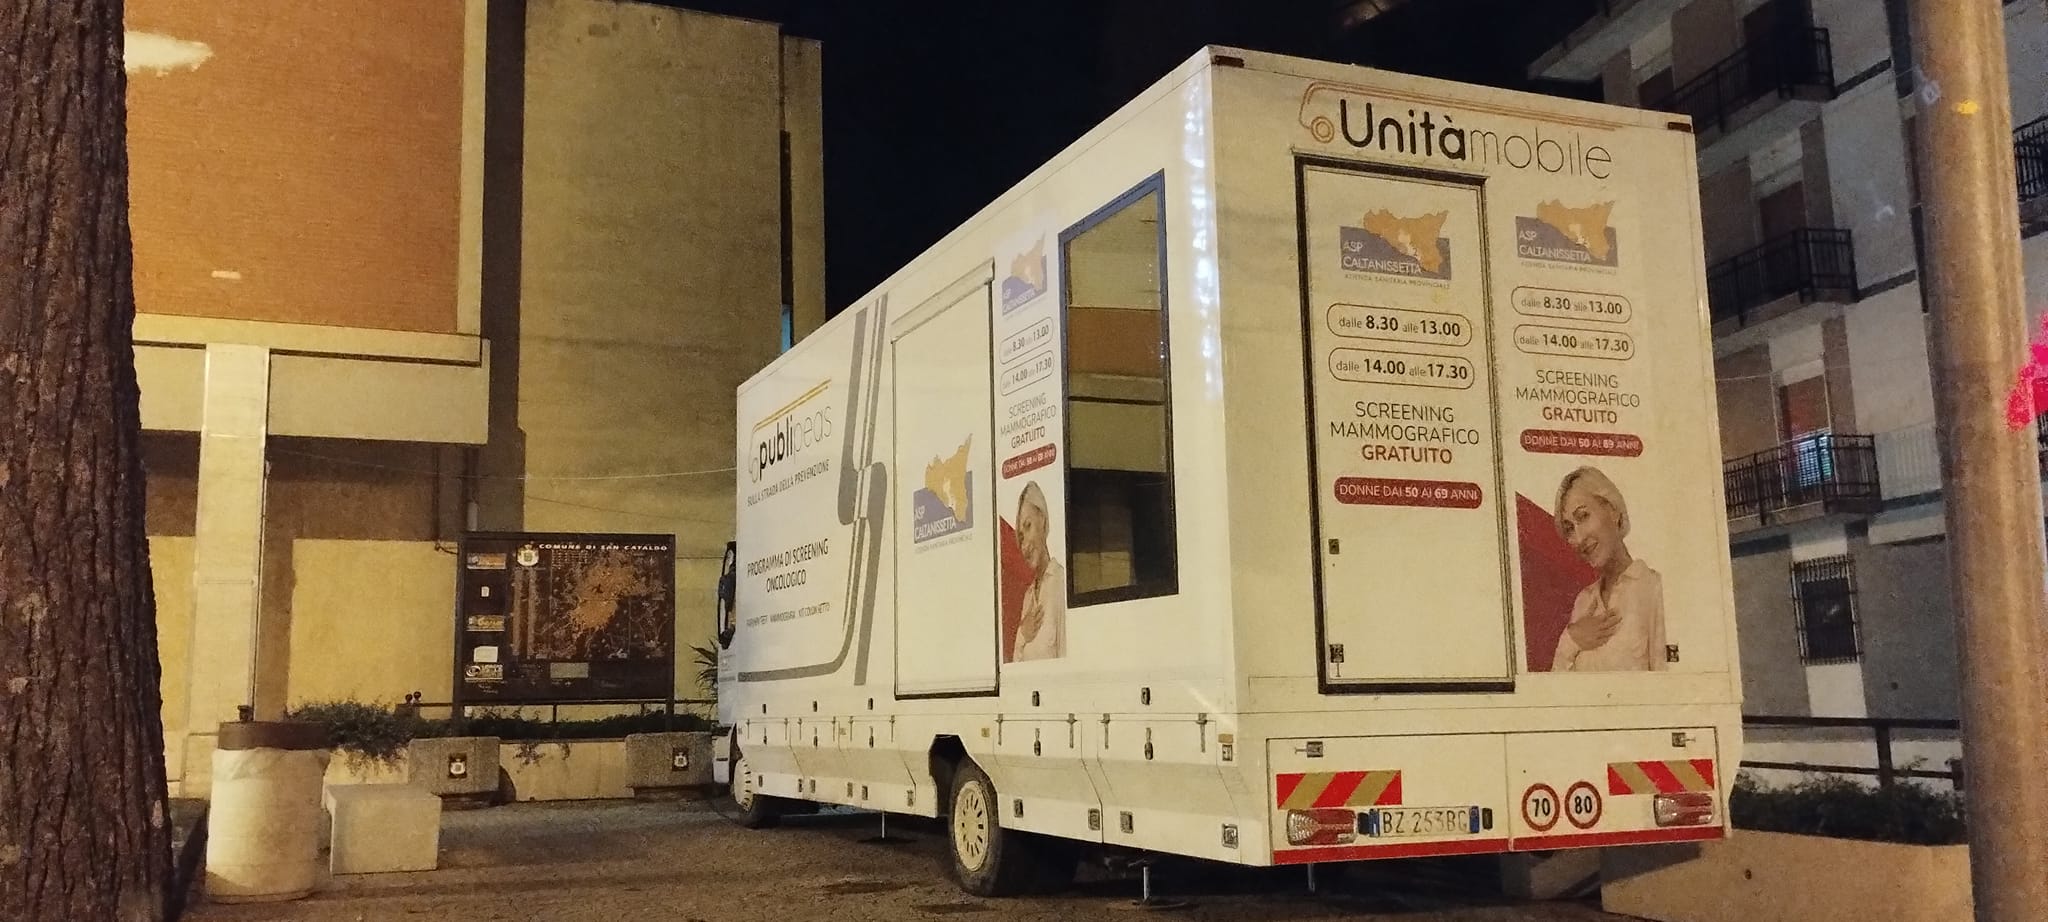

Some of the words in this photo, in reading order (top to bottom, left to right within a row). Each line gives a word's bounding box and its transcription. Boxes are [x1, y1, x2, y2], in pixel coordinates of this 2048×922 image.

[1519, 230, 1537, 240] ASP
[1343, 241, 1363, 252] ASP
[1519, 245, 1591, 262] CALTANISSETTA
[1343, 256, 1421, 273] CALTANISSETTA
[1543, 296, 1571, 310] 8.30
[1588, 300, 1623, 315] 13.00
[1033, 325, 1049, 341] 13.00
[1339, 317, 1362, 328] dalle
[1366, 315, 1399, 331] 8.30
[1402, 323, 1418, 333] alle
[1420, 320, 1460, 337] 13.00
[1543, 334, 1577, 348] 14.00
[1596, 338, 1629, 352] 17.30
[1036, 357, 1052, 373] 17.30
[1336, 361, 1359, 372] dalle
[1364, 358, 1405, 375] 14.00
[1409, 367, 1426, 376] alle
[1428, 363, 1467, 380] 17.30
[1536, 370, 1618, 388] SCREENING
[1008, 392, 1046, 419] SCREENING
[1516, 387, 1640, 407] MAMMOGRAFICO
[1000, 405, 1056, 436] MAMMOGRAFICO
[1355, 401, 1454, 423] SCREENING
[1542, 407, 1617, 424] GRATUITO
[1011, 426, 1045, 448] GRATUITO
[1330, 421, 1480, 445] MAMMOGRAFICO
[1524, 435, 1558, 445] DONNE
[1560, 437, 1576, 447] DAI
[1579, 438, 1590, 448] 50
[1616, 440, 1639, 449] ANNI
[1362, 444, 1453, 464] GRATUITO
[1339, 484, 1380, 497] DONNE
[1383, 485, 1402, 497] DAI
[1405, 486, 1418, 498] 50
[1421, 488, 1432, 498] AI
[1434, 488, 1448, 499] 69
[1450, 489, 1478, 500] ANNI
[914, 516, 956, 539] CALTANISSETTA
[747, 553, 783, 577] PROGRAMMA
[784, 551, 791, 566] DI
[793, 538, 828, 564] SCREENING
[766, 569, 807, 593] ONCOLOGICO
[1531, 799, 1550, 817] 70
[1575, 796, 1592, 814] 80
[1383, 811, 1404, 833] BZ
